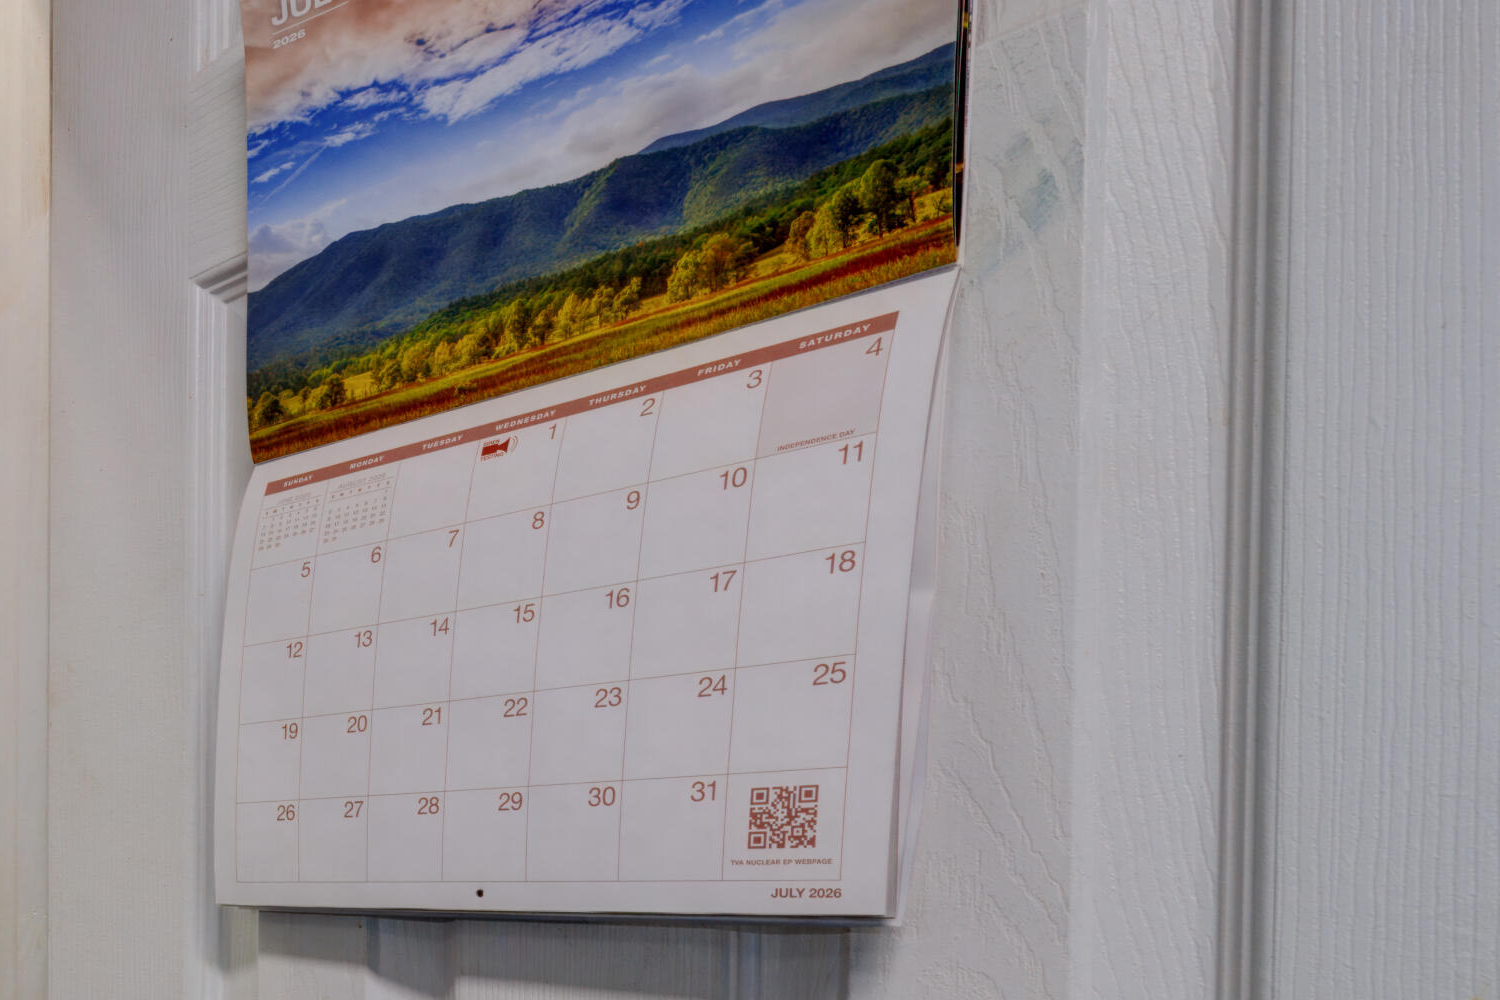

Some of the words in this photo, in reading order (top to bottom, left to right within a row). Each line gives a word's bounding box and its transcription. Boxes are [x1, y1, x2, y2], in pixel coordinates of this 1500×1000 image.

[272, 29, 306, 49] 2026
[799, 323, 872, 350] SATURDAY
[865, 337, 884, 357] 4
[697, 358, 742, 377] FRIDAY
[746, 369, 764, 390] 3
[588, 384, 648, 407] THURSDAY
[639, 398, 657, 417] 2
[495, 409, 557, 432] WEDNESDAY
[548, 424, 557, 440] 1
[777, 433, 837, 453] INDEPENDENCE
[839, 429, 856, 440] DAY
[422, 435, 464, 451] TUESDAY
[838, 440, 864, 465] 11
[349, 456, 385, 471] MONDAY
[284, 474, 313, 488] SUNDAY
[719, 467, 748, 490] 10
[625, 490, 641, 511] 9
[531, 510, 546, 530] 8
[448, 529, 460, 548] 7
[371, 545, 382, 564] 6
[824, 550, 857, 575] 18
[300, 561, 312, 578] 5
[709, 569, 737, 593] 17
[604, 587, 631, 610] 16
[512, 603, 536, 624] 15
[430, 617, 450, 637] 14
[354, 629, 374, 648] 13
[285, 641, 303, 659] 12
[811, 661, 847, 686] 25
[697, 675, 728, 698] 24
[502, 697, 528, 718] 22
[593, 687, 623, 709] 23
[346, 714, 368, 734] 20
[421, 707, 443, 726] 21
[281, 722, 298, 740] 19
[587, 786, 616, 807] 30
[690, 780, 718, 802] 31
[343, 801, 364, 818] 27
[417, 796, 440, 816] 28
[498, 791, 524, 812] 29
[276, 805, 296, 821] 26
[771, 887, 806, 899] JULY
[808, 887, 842, 899] 2026
